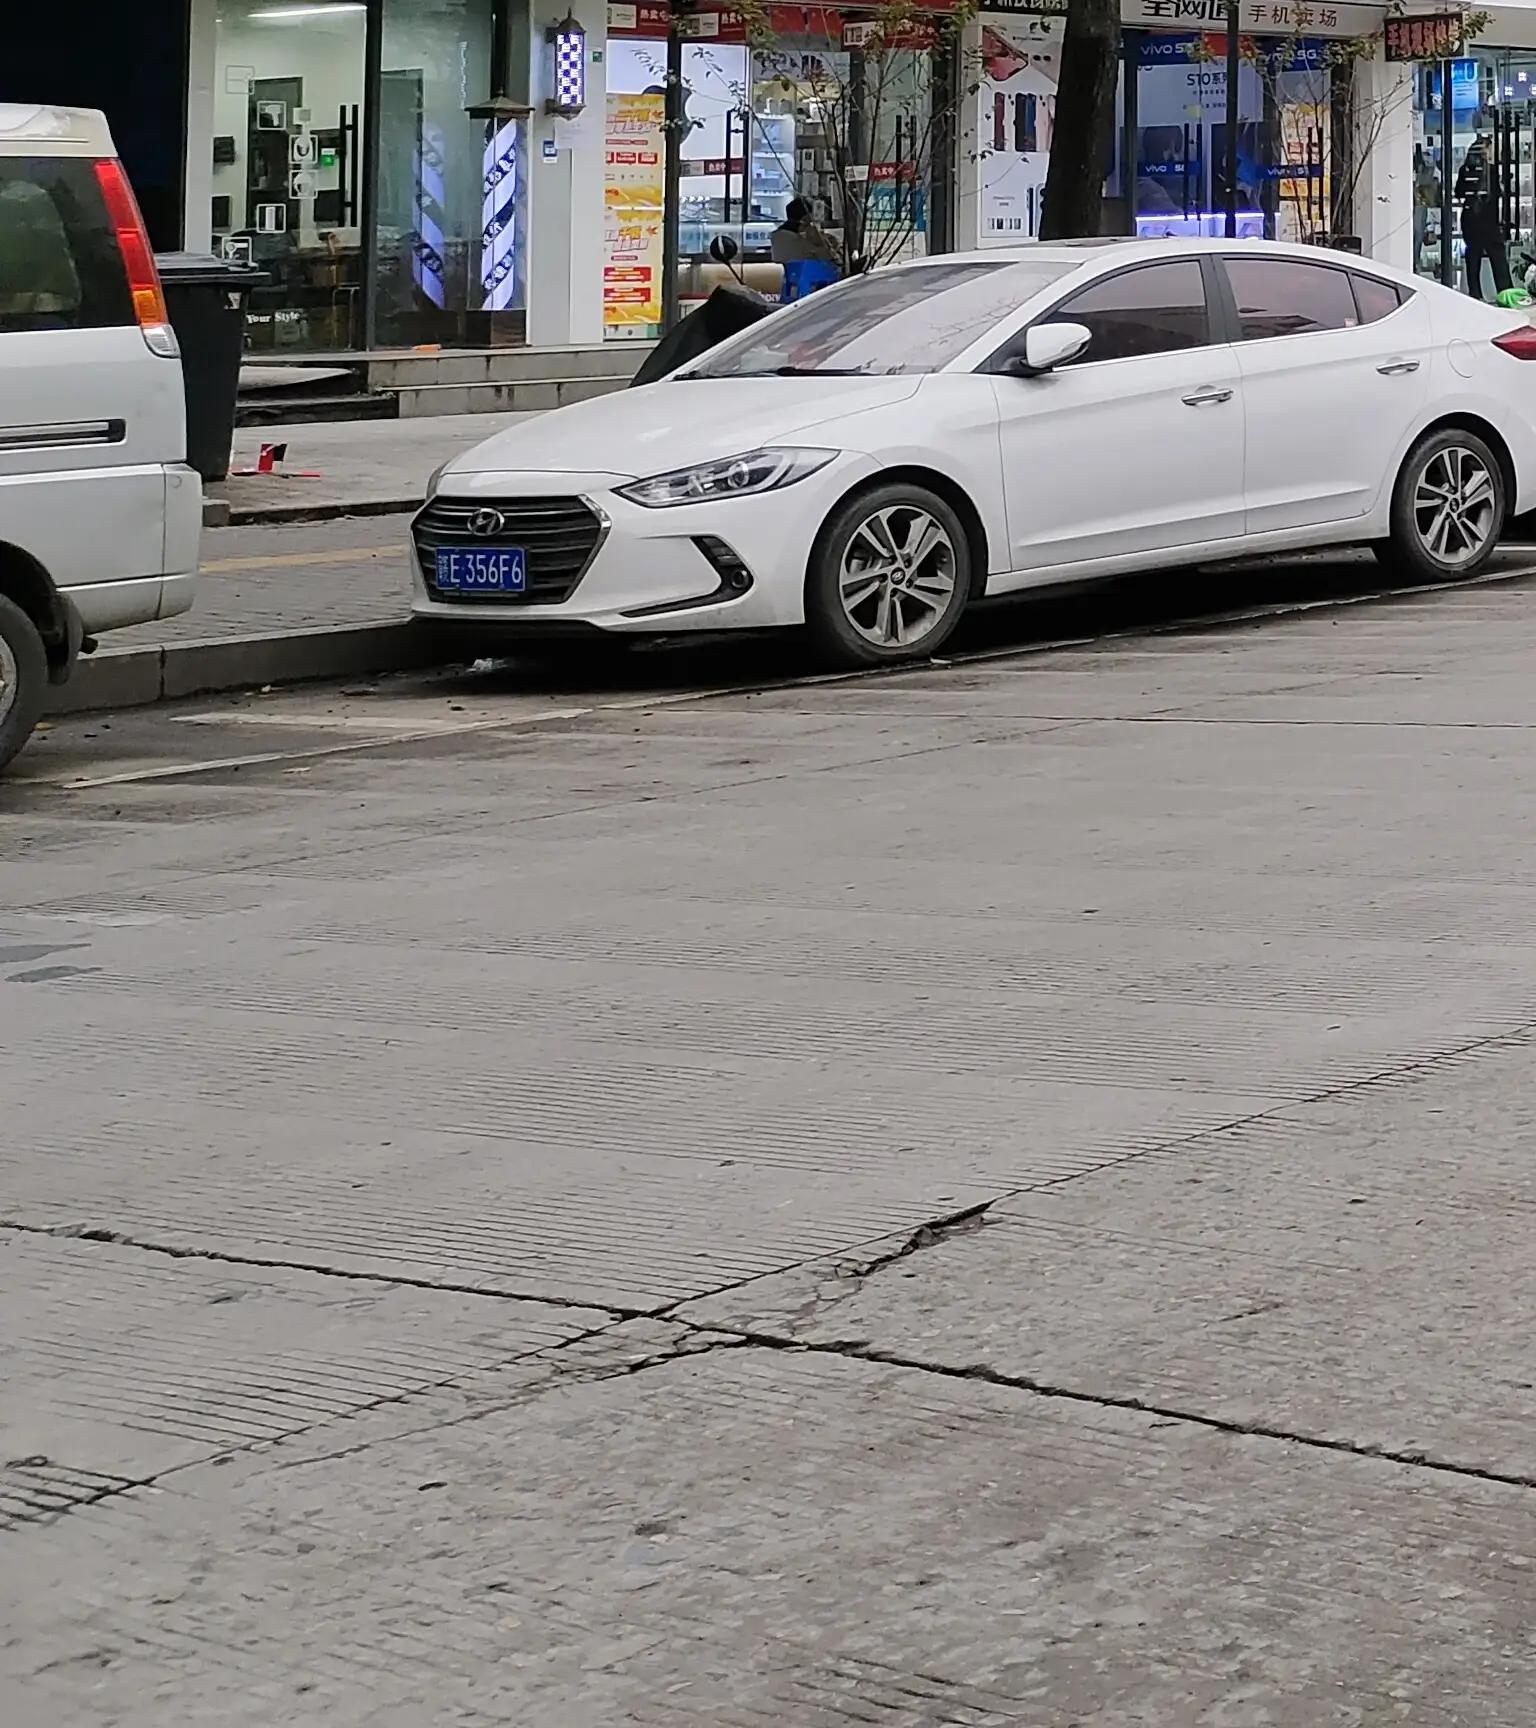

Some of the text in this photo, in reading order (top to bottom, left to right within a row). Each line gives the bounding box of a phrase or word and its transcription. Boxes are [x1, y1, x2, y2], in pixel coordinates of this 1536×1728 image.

[1248, 4, 1338, 28] 手机卖场
[1140, 44, 1173, 57] vivo
